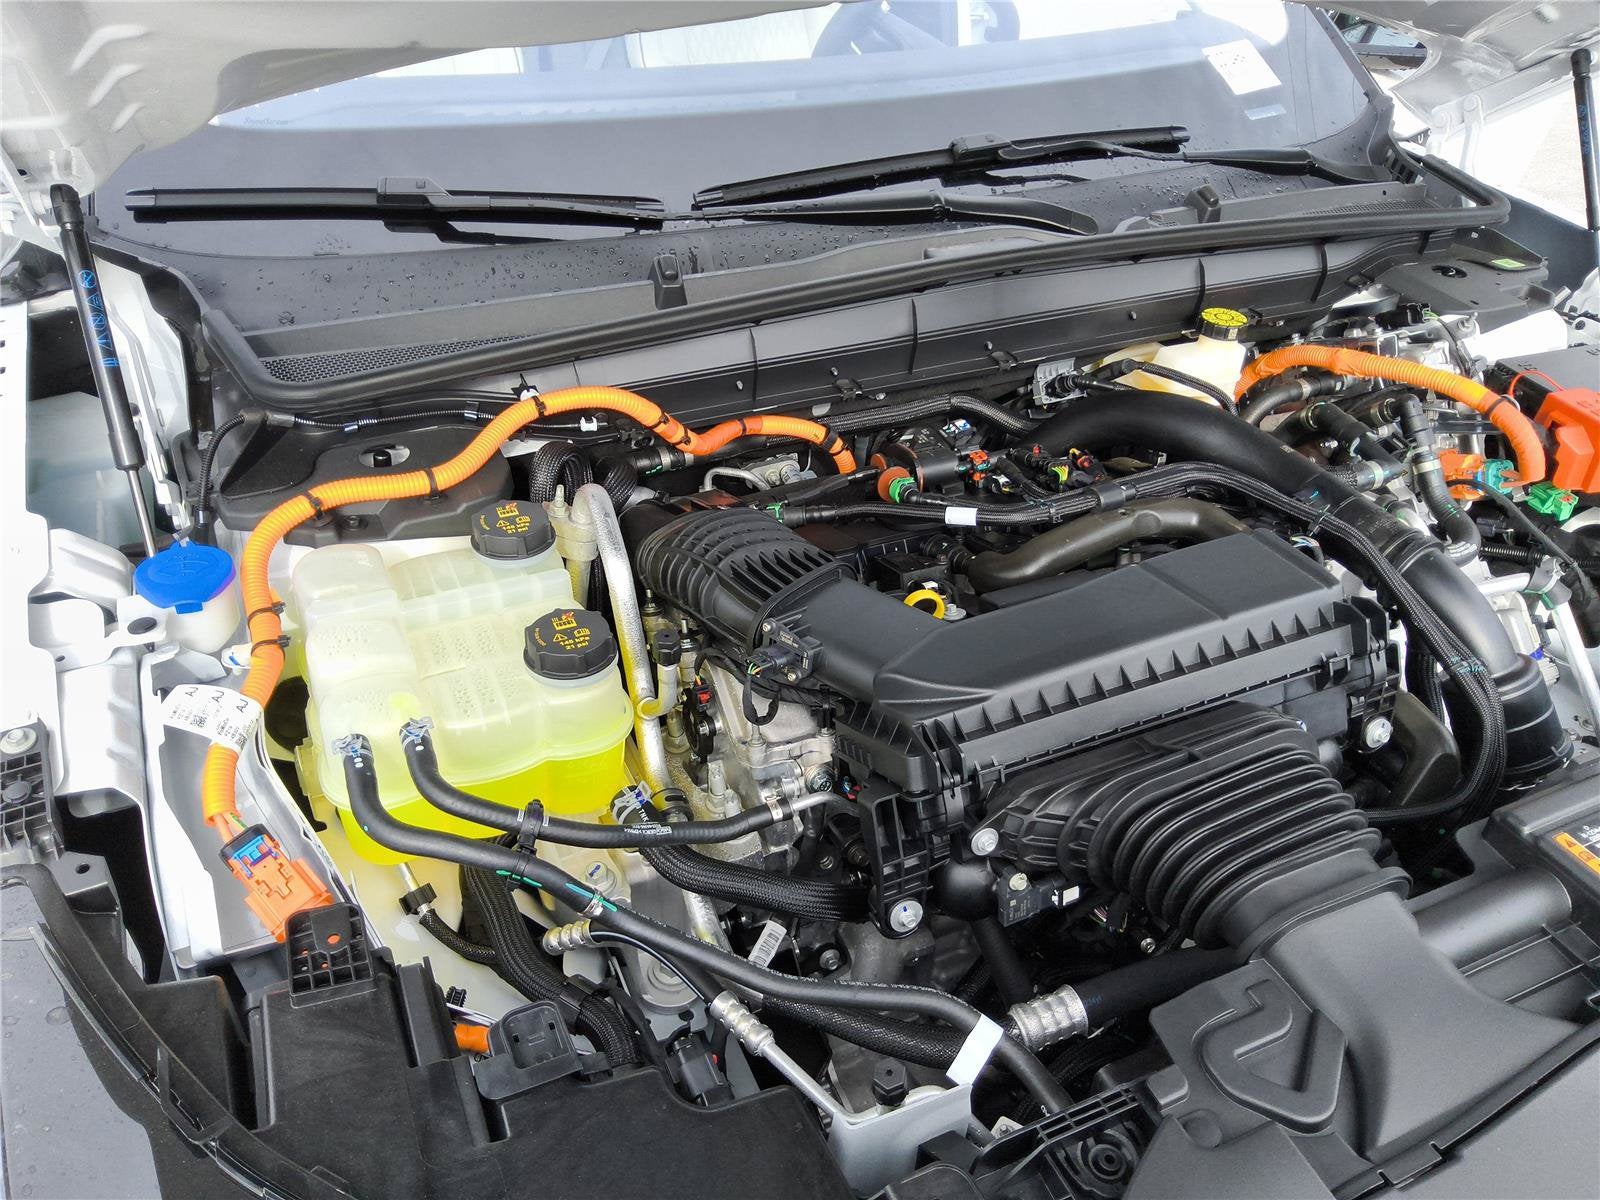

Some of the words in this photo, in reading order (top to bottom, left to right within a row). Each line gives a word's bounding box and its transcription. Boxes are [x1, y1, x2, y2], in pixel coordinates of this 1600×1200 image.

[185, 686, 198, 697] AJ
[211, 690, 225, 702] AJ
[236, 698, 249, 713] AJ
